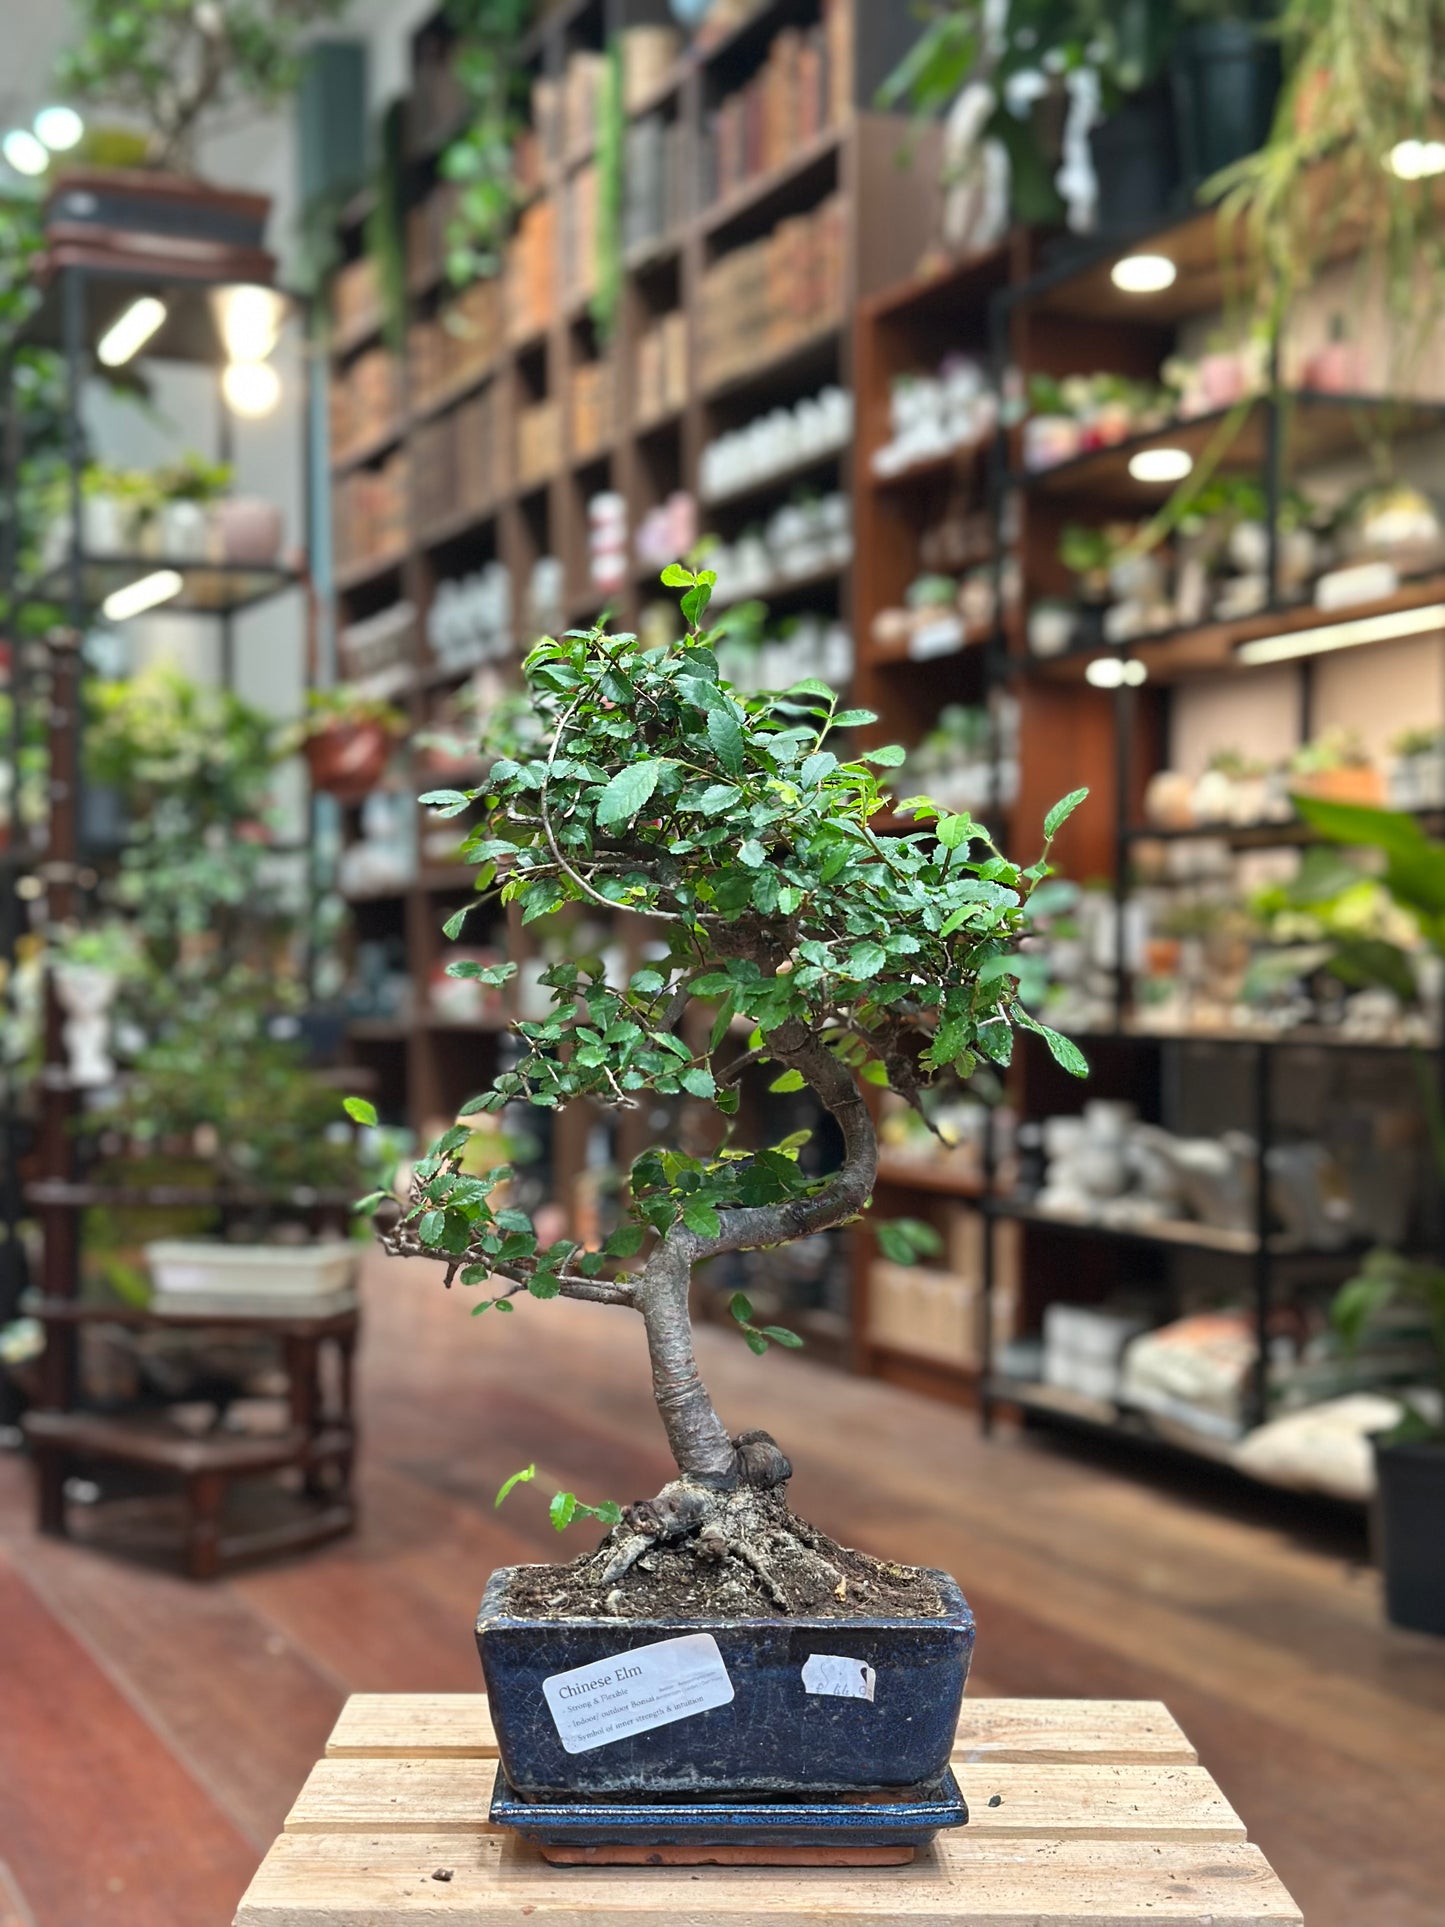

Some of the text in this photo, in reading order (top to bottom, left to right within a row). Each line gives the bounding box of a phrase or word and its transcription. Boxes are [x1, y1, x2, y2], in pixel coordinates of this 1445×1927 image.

[558, 1675, 612, 1699] Chinese
[614, 1665, 643, 1682] Elm
[567, 1701, 593, 1713] Strong
[593, 1697, 600, 1705] &
[601, 1688, 629, 1702] Flexible
[601, 1704, 630, 1718] outdoor
[630, 1695, 656, 1709] Bonsai
[577, 1694, 705, 1742] Symbol of inner strength & intuition
